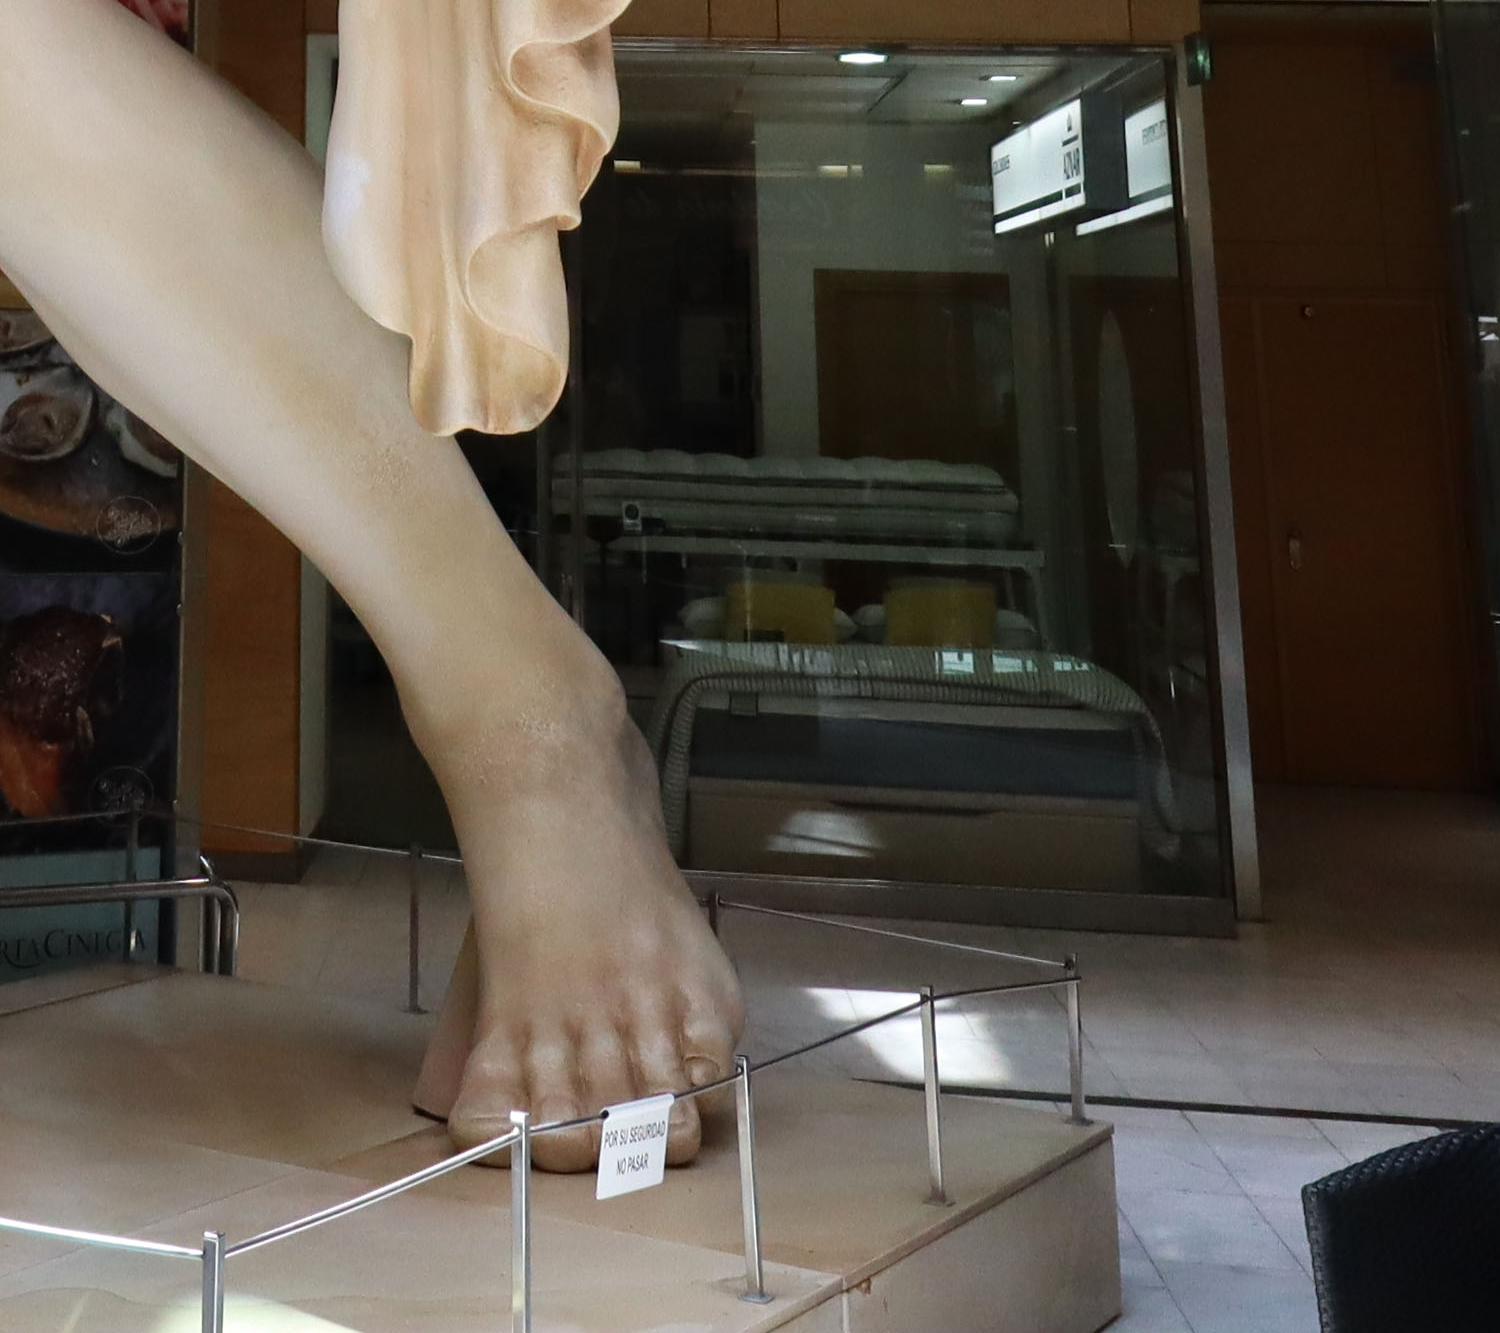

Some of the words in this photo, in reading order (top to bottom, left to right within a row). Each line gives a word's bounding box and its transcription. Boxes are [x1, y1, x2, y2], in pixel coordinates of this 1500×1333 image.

[603, 1129, 618, 1149] POR
[619, 1127, 629, 1146] SU
[630, 1120, 667, 1144] SEGURIDAD
[616, 1160, 627, 1175] NO
[627, 1153, 649, 1173] PASAR
